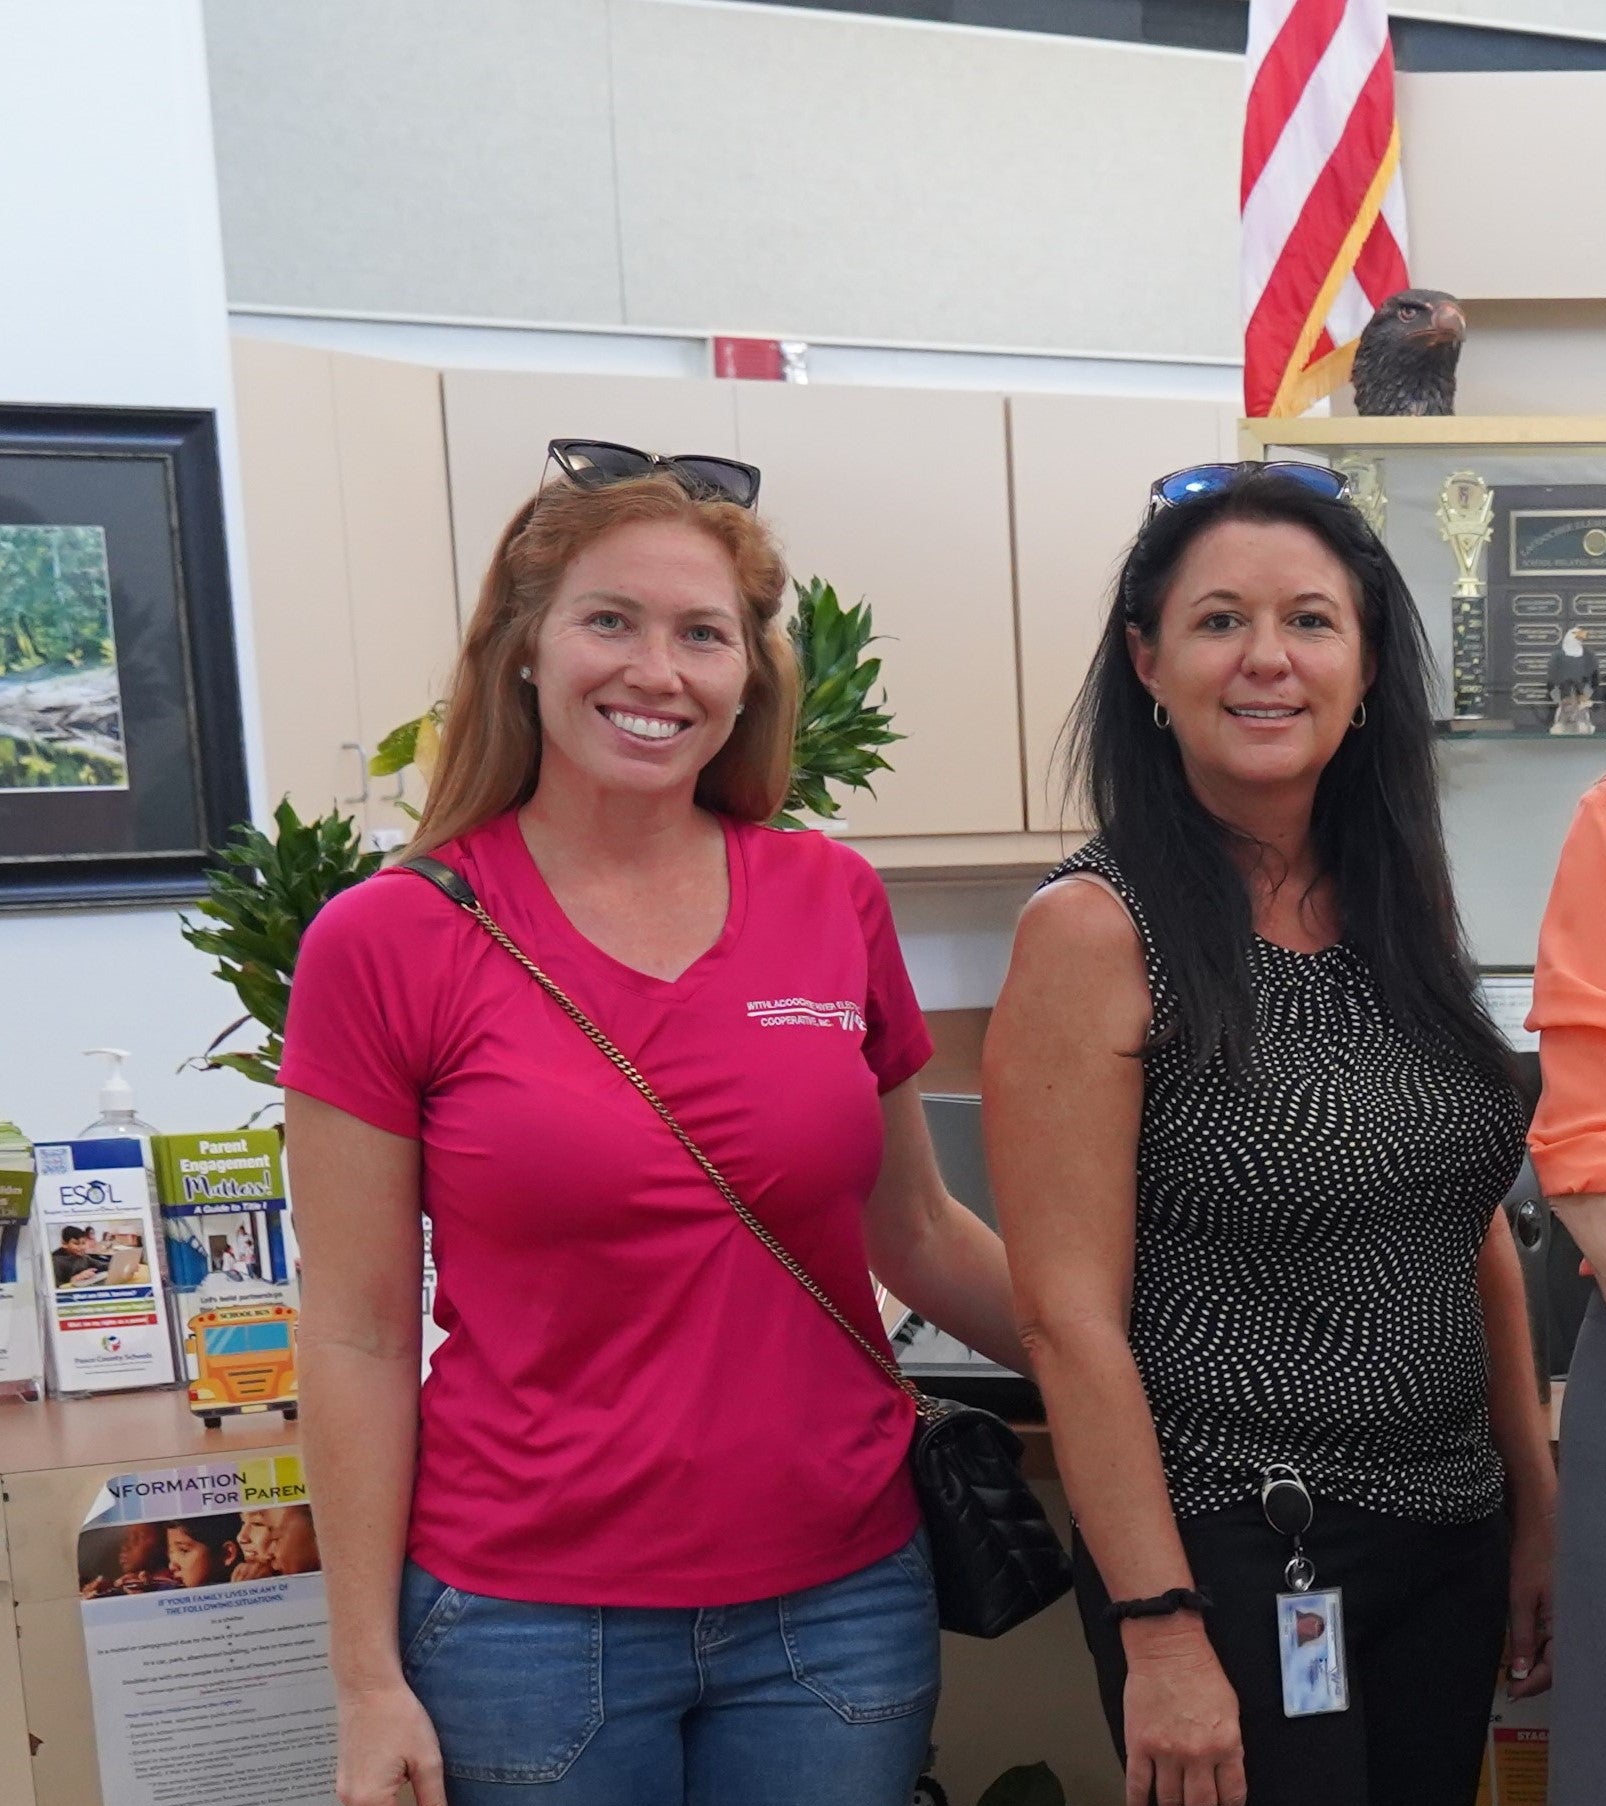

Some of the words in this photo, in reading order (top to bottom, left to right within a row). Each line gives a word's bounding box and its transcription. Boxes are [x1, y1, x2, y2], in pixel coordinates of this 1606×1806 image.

[200, 1140, 248, 1155] Parent
[180, 1154, 270, 1173] Engagement
[60, 1180, 122, 1205] ESOL
